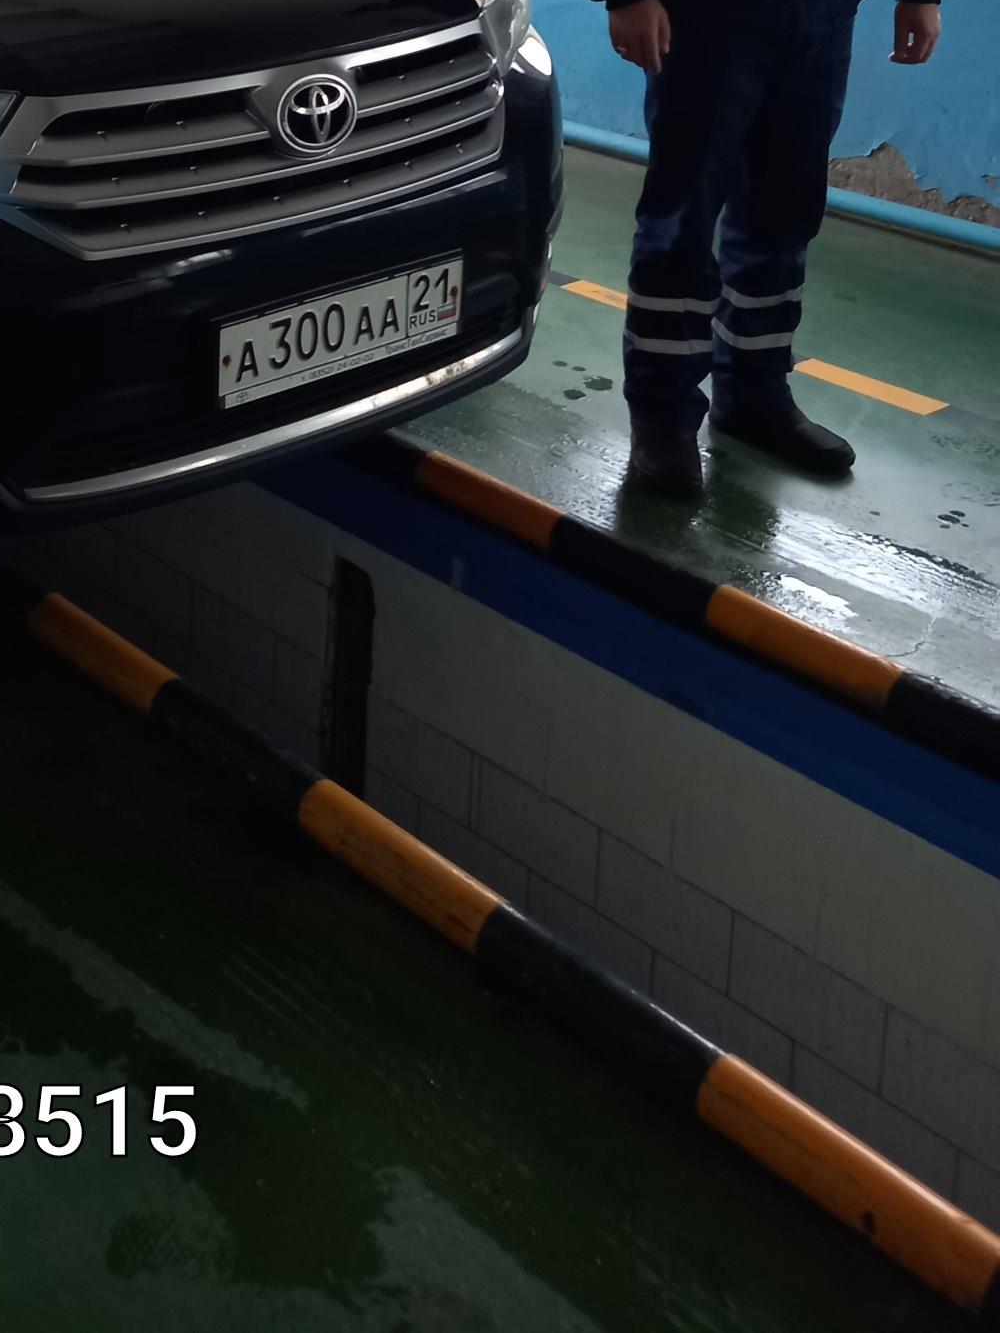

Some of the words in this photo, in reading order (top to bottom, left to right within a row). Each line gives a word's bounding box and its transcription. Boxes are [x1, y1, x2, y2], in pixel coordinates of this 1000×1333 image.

[411, 268, 450, 312] 21
[235, 298, 400, 382] А300АА
[409, 309, 436, 329] RUS
